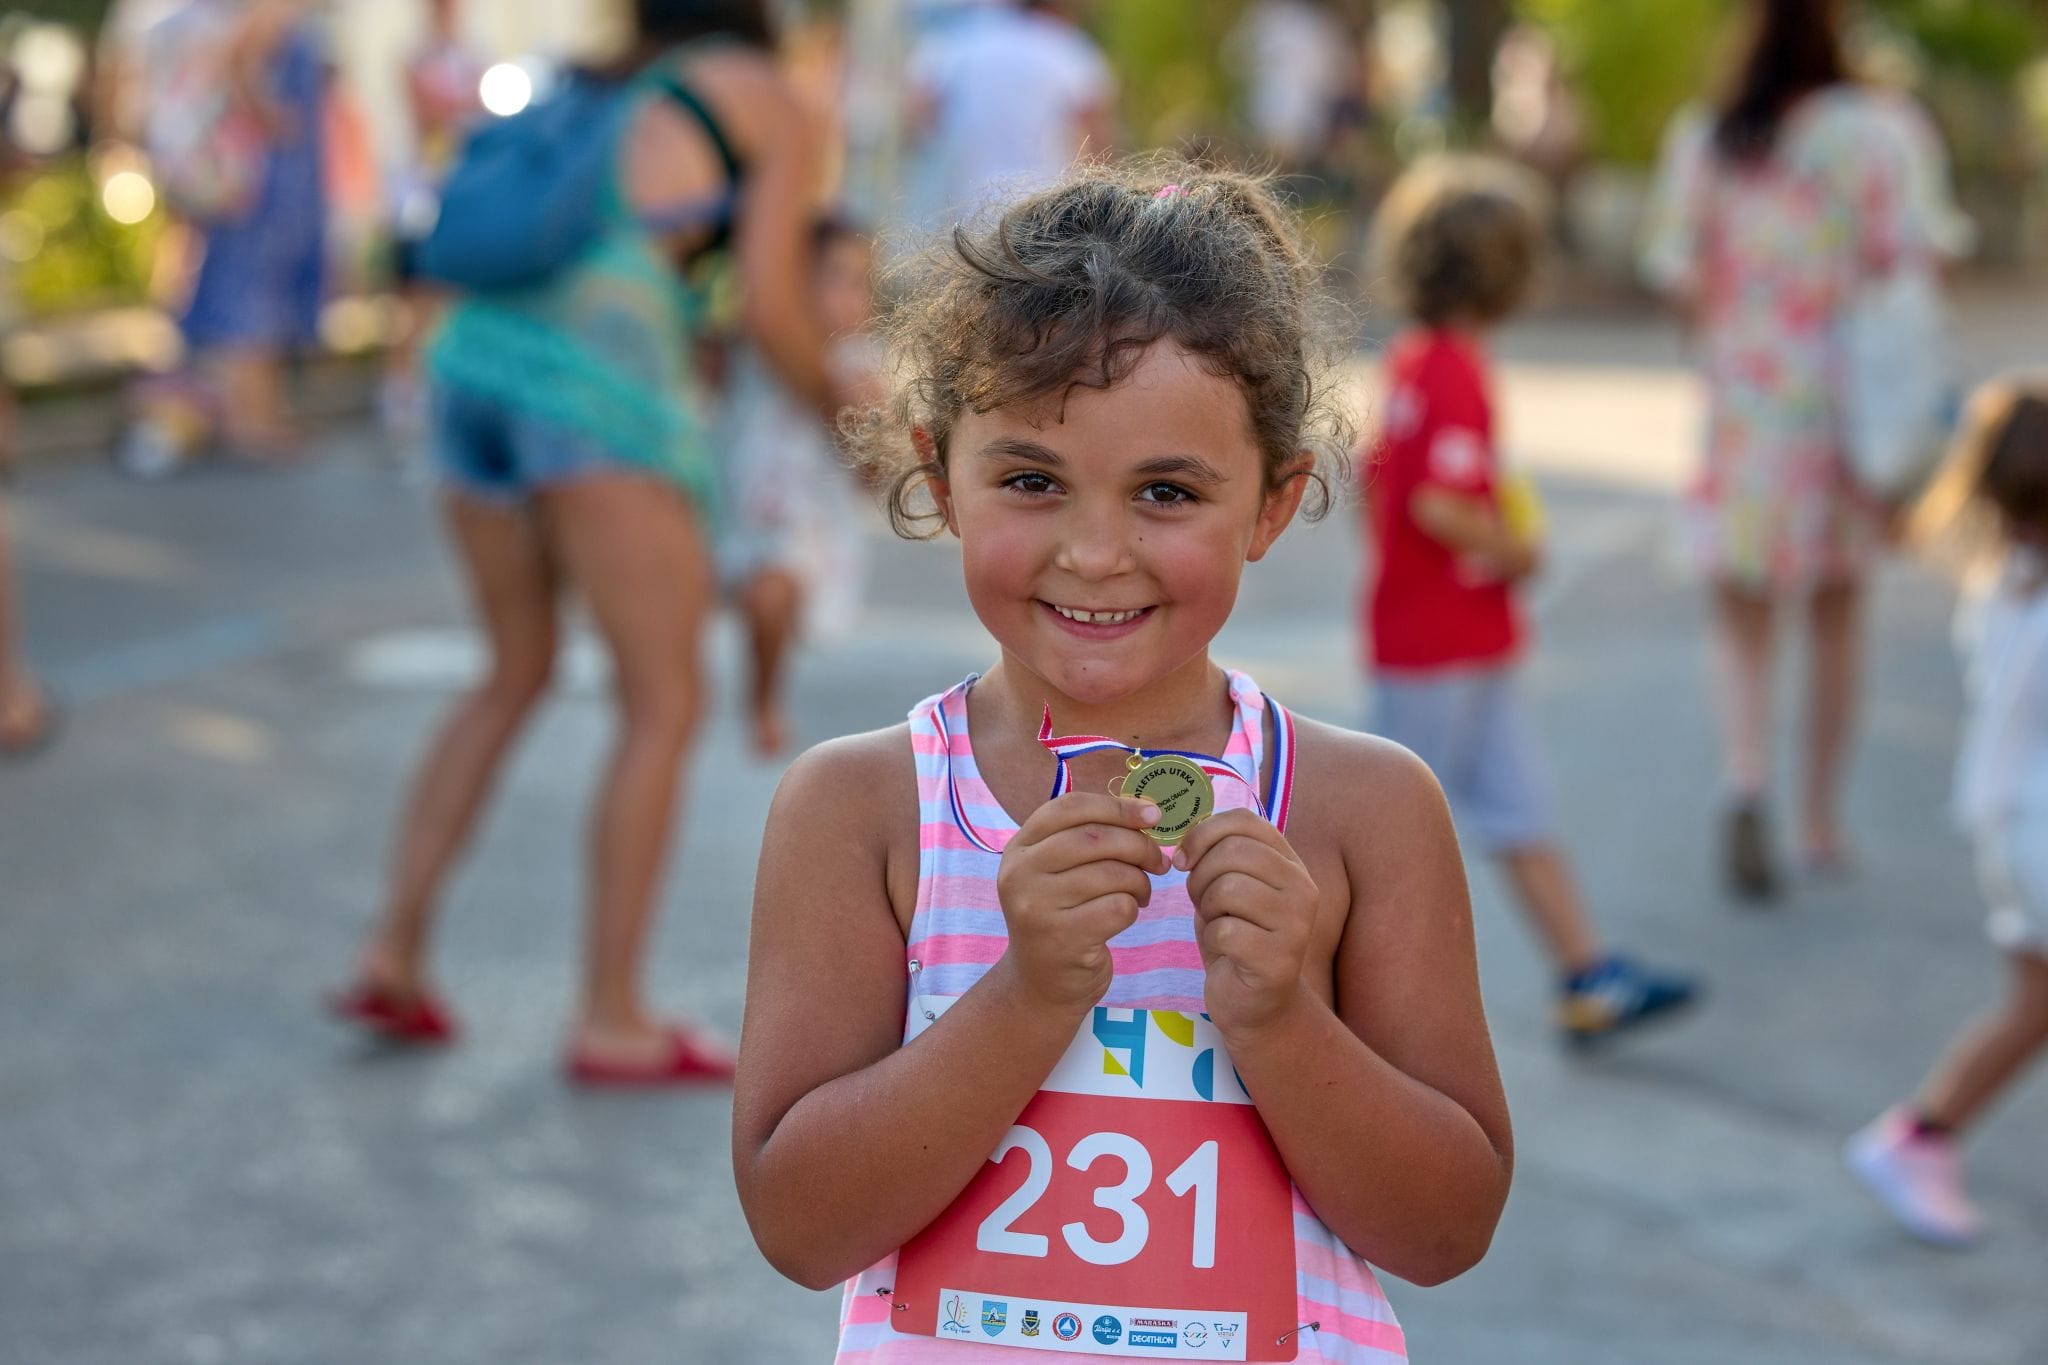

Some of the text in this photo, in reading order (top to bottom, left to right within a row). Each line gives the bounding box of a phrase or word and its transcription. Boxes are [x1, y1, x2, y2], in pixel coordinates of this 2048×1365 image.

[1135, 768, 1195, 798] ATLETSKA UTRKA
[976, 1124, 1219, 1268] 231
[1136, 1319, 1172, 1327] MARASKA
[1131, 1333, 1174, 1345] DECATHLON
